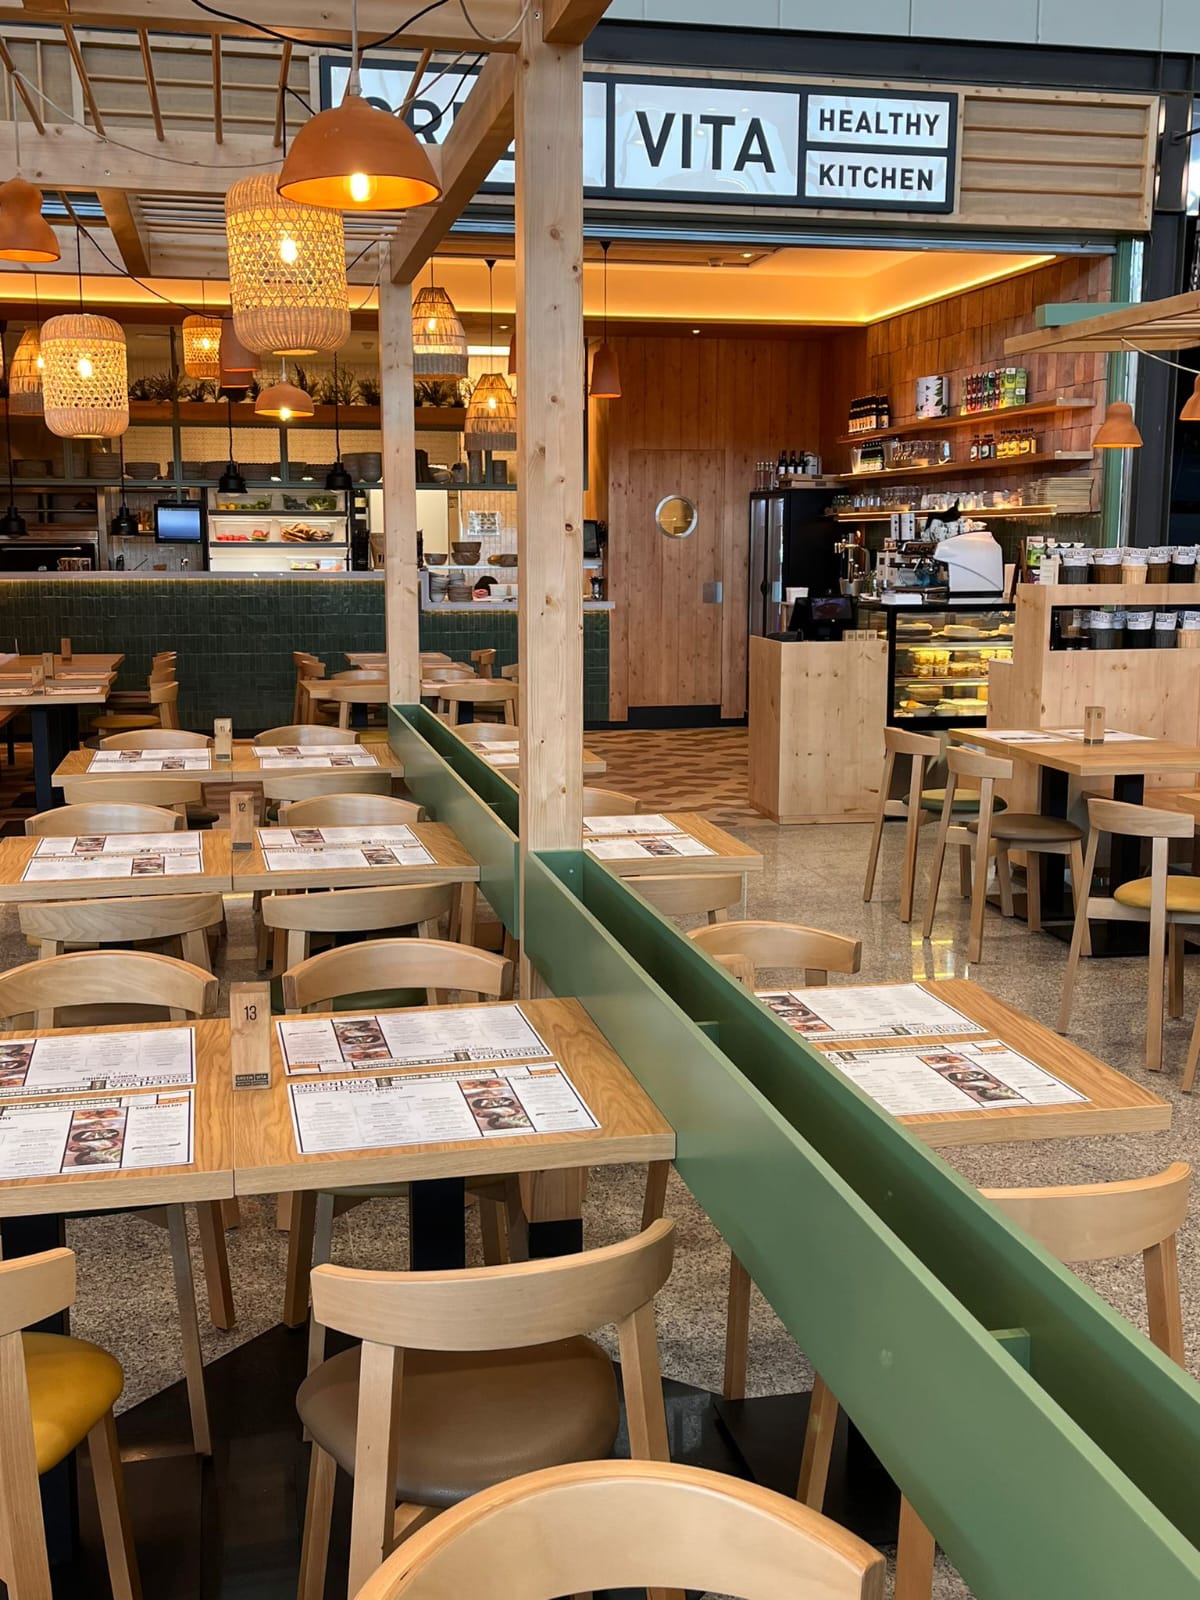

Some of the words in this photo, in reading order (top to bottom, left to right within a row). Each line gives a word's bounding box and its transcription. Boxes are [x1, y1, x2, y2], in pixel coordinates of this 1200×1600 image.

[819, 108, 940, 137] HEALTHY
[635, 110, 776, 173] VITA
[819, 163, 934, 192] KITCHEN
[238, 802, 246, 812] 12
[244, 1005, 257, 1021] 13
